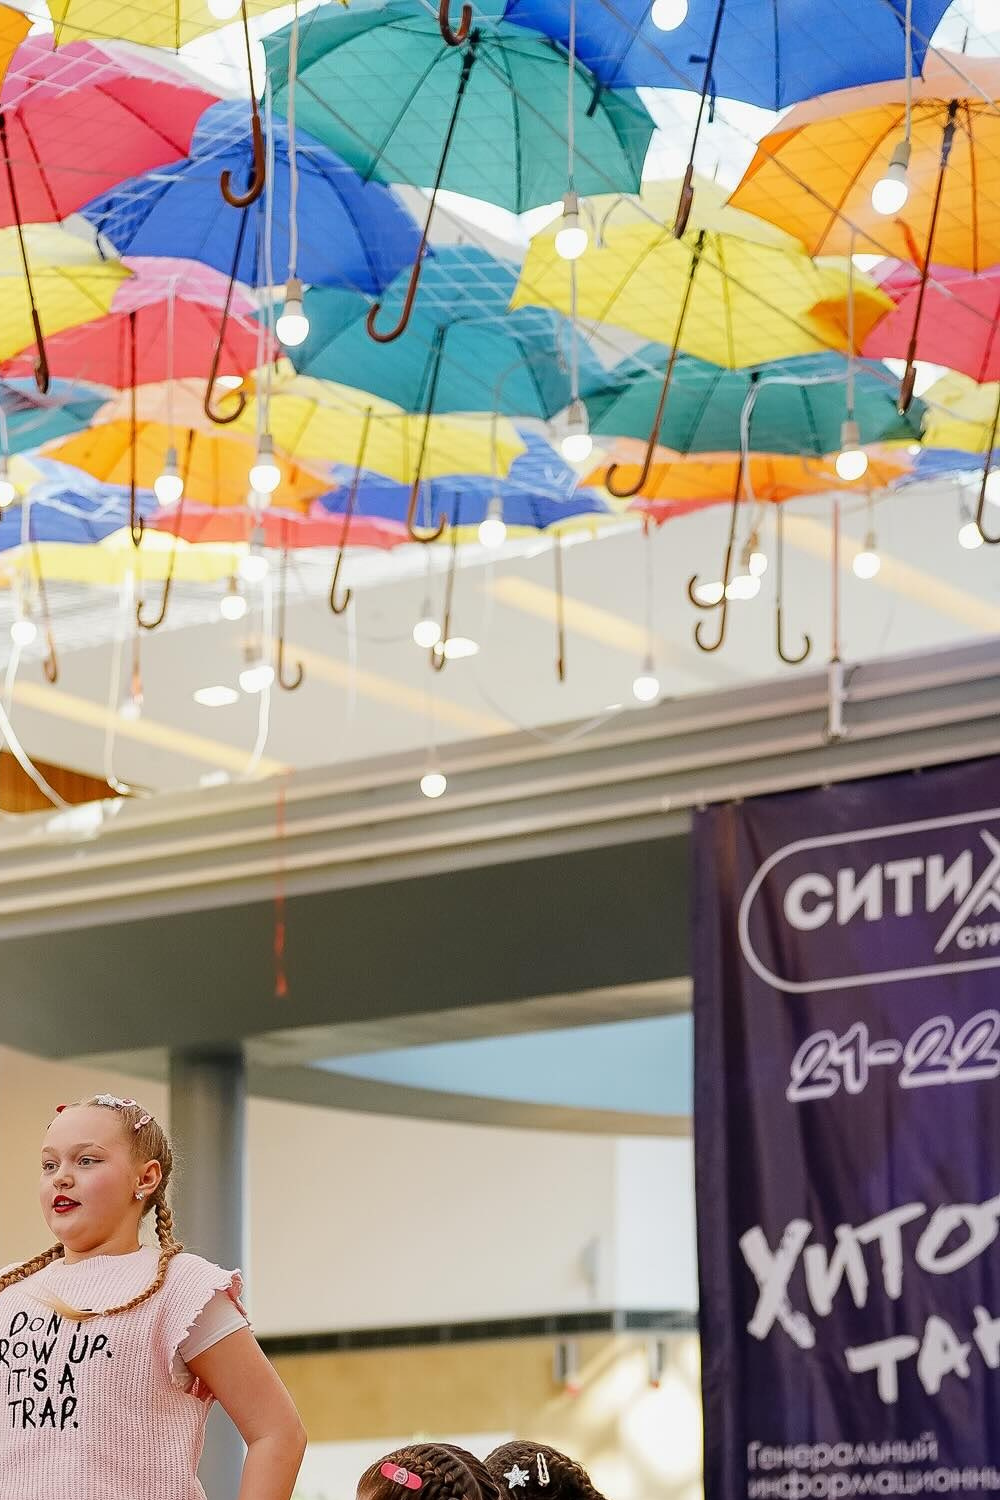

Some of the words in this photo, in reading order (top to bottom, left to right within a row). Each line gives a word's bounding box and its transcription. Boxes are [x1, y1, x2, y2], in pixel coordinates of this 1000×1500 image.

[783, 848, 973, 931] СИТИ
[739, 1195, 1000, 1349] ХИТО
[68, 1334, 113, 1364] UP.
[7, 1366, 48, 1396] IT'S
[58, 1363, 75, 1394] A
[8, 1396, 79, 1431] TRAP.
[747, 1431, 938, 1472] Генеральный
